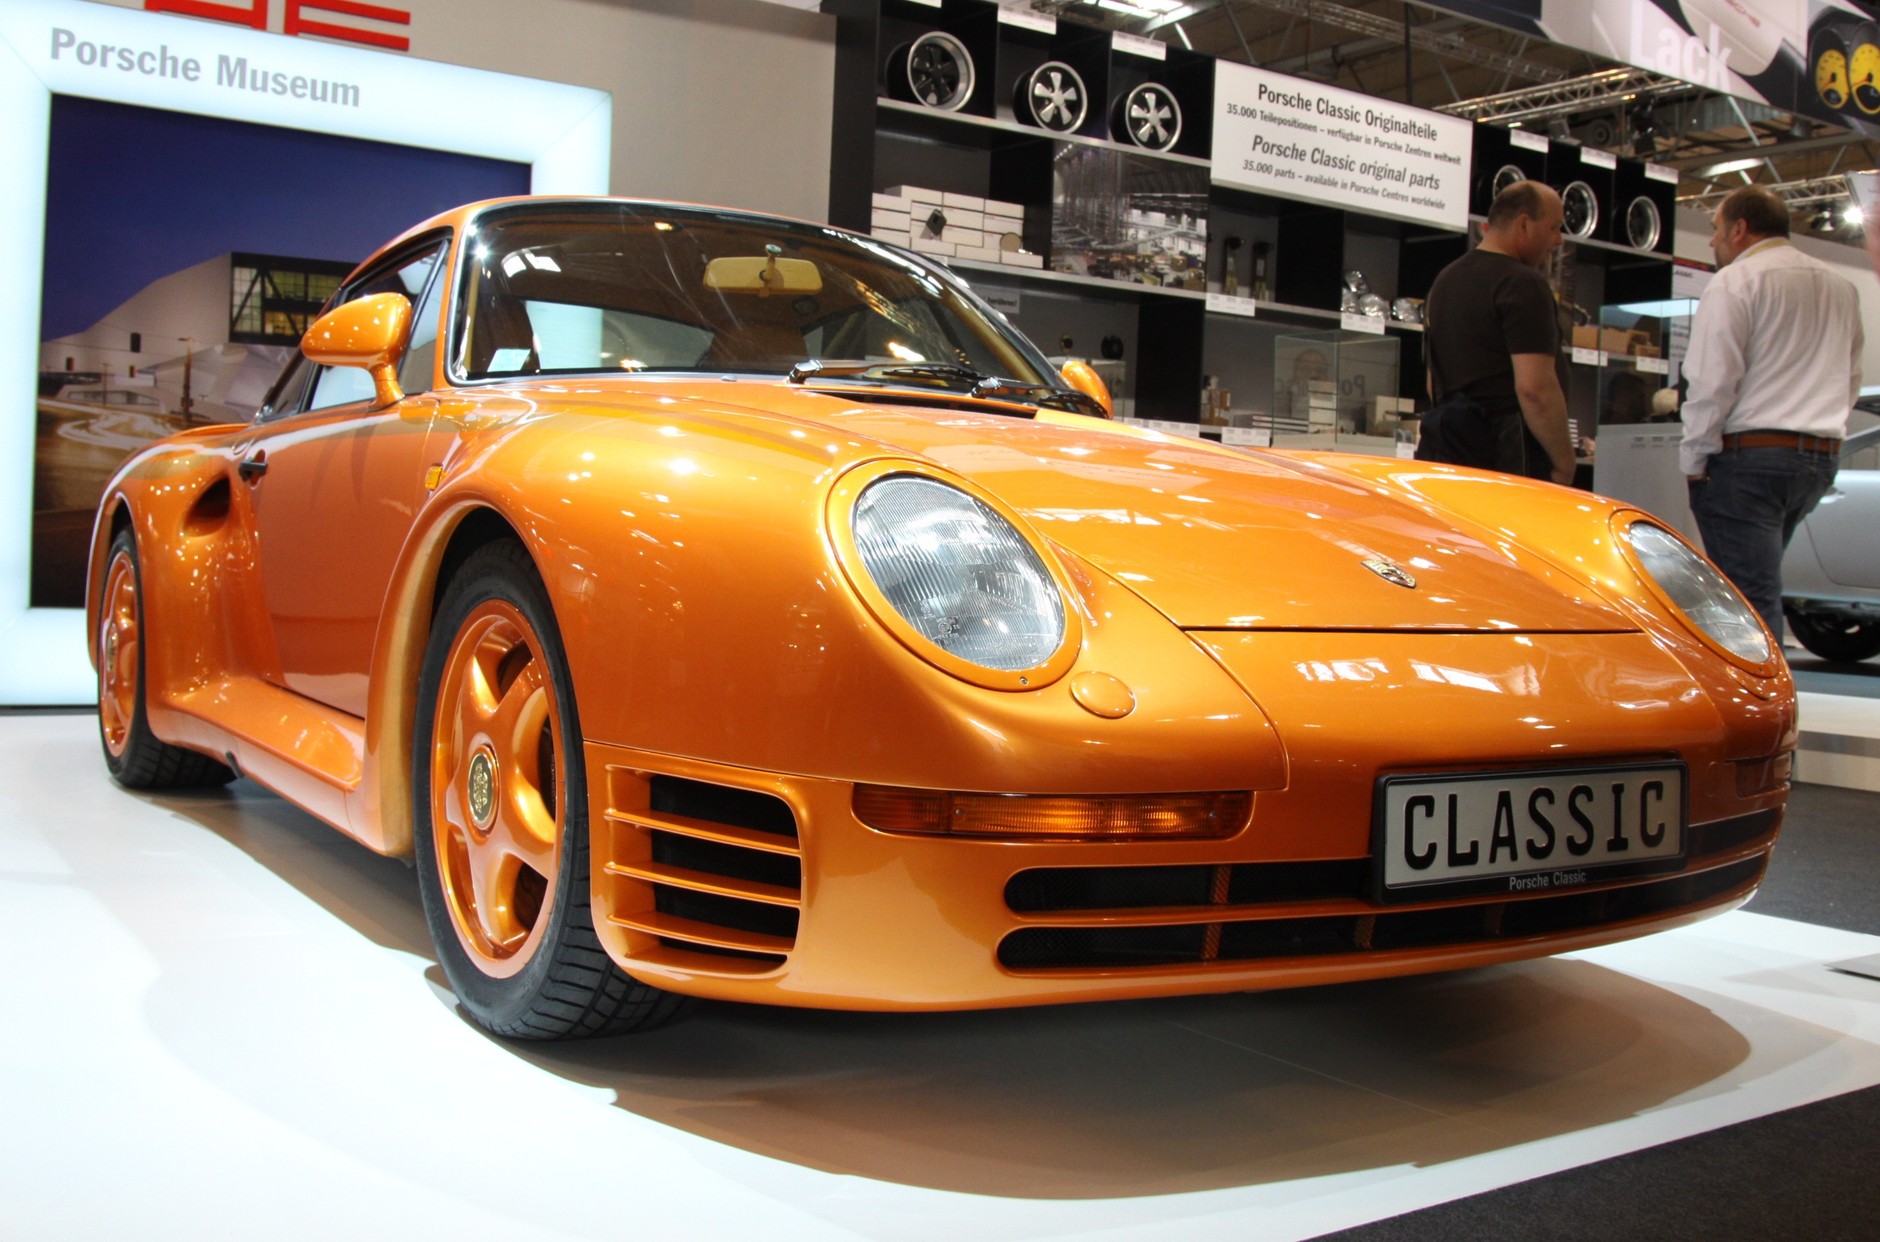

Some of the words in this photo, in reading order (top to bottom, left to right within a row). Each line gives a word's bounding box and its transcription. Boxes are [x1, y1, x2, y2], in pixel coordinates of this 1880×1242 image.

[51, 27, 202, 82] Porsche
[217, 54, 361, 107] Museum
[1630, 0, 1732, 94] Lack
[1227, 103, 1257, 119] 35.000
[1259, 110, 1318, 133] Teilepositionen
[1327, 127, 1363, 143] verfügbar
[1364, 134, 1372, 145] in
[1373, 136, 1403, 152] Porsche
[1433, 151, 1462, 165] weltweit
[1258, 83, 1312, 112] Porsche
[1316, 97, 1361, 123] Classic
[1365, 109, 1438, 141] Originalteile
[1242, 159, 1273, 175] 35.000
[1274, 167, 1296, 179] parts
[1304, 173, 1339, 188] available
[1340, 179, 1348, 189] in
[1349, 181, 1380, 197] Porsche
[1381, 187, 1409, 202] Centres
[1410, 195, 1446, 210] worldwide
[1252, 135, 1307, 162] Porsche
[1311, 147, 1356, 172] Classic
[1359, 160, 1407, 181] original
[1408, 172, 1441, 190] parts
[1403, 780, 1666, 871] CLASSIC
[1509, 873, 1550, 891] Porsche
[1553, 869, 1587, 885] Classic
